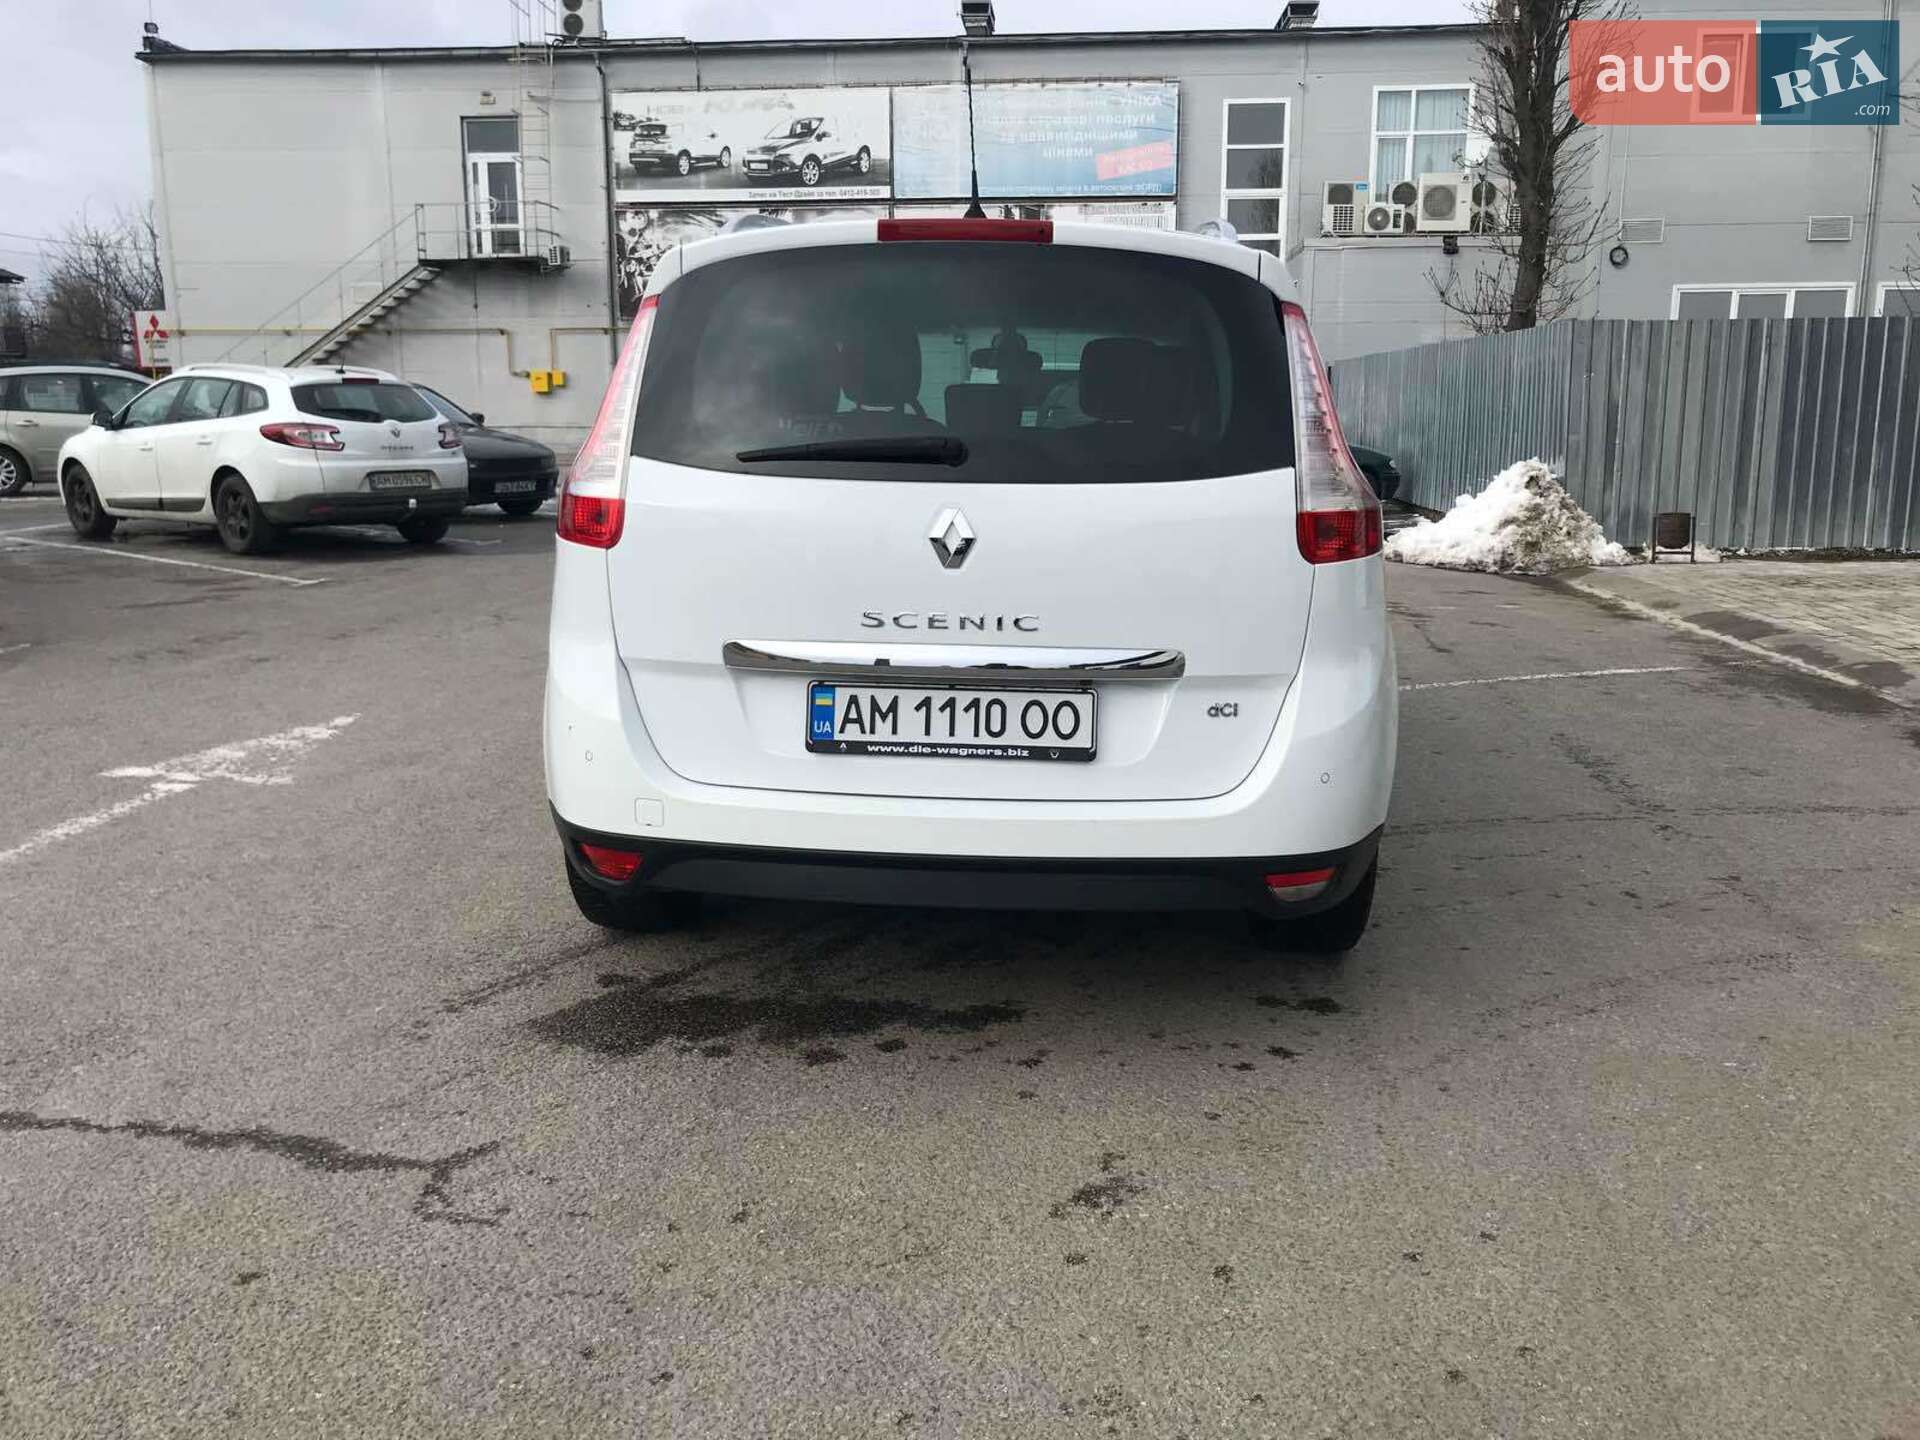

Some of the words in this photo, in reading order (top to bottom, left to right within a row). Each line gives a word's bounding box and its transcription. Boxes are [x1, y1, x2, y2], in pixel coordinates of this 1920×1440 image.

[861, 611, 1040, 632] SCENIC
[814, 720, 832, 733] UA
[838, 694, 899, 735] AM
[914, 696, 1007, 738] 1110
[867, 743, 1030, 757] www.die-wagners.biz
